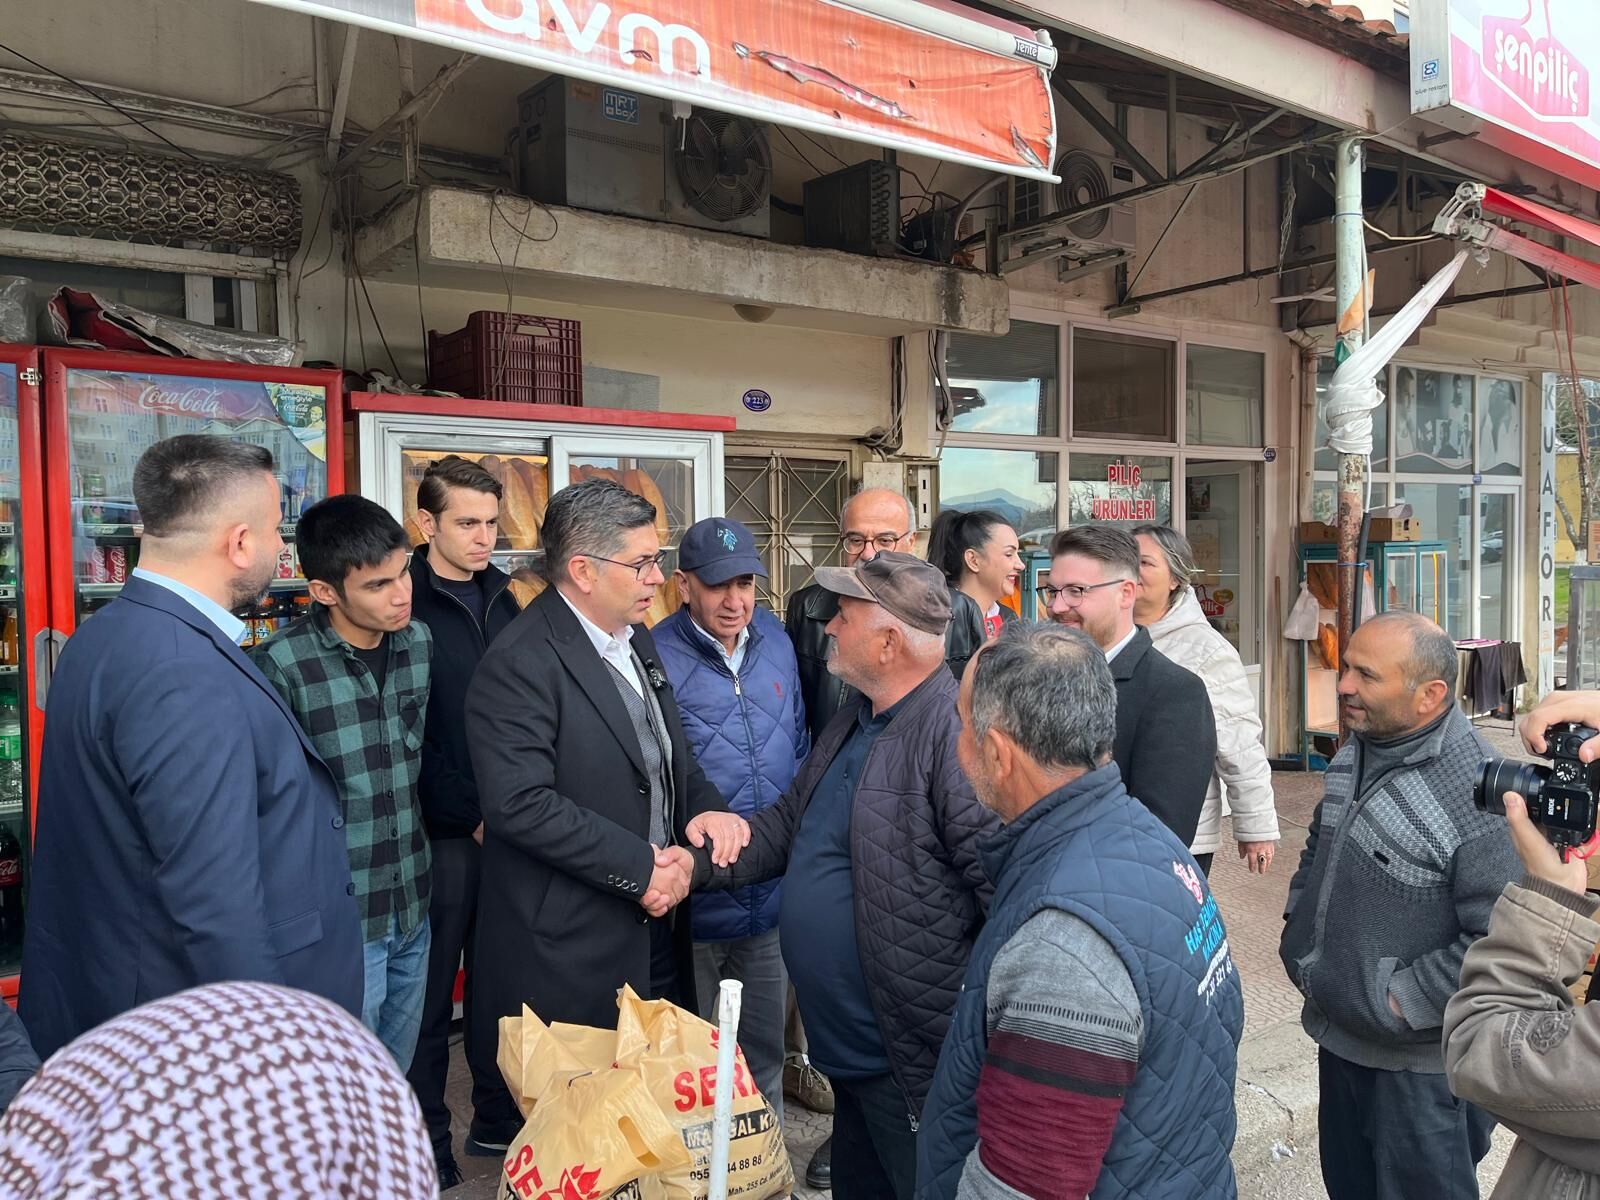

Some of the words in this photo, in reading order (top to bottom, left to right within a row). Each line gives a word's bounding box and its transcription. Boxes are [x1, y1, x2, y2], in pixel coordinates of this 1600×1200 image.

[1107, 459, 1142, 491] PİLİÇ
[1092, 495, 1155, 520] ÜRÜNLERİ
[686, 1117, 757, 1148] MAGAL
[739, 1158, 750, 1170] 88
[752, 1154, 762, 1166] 88
